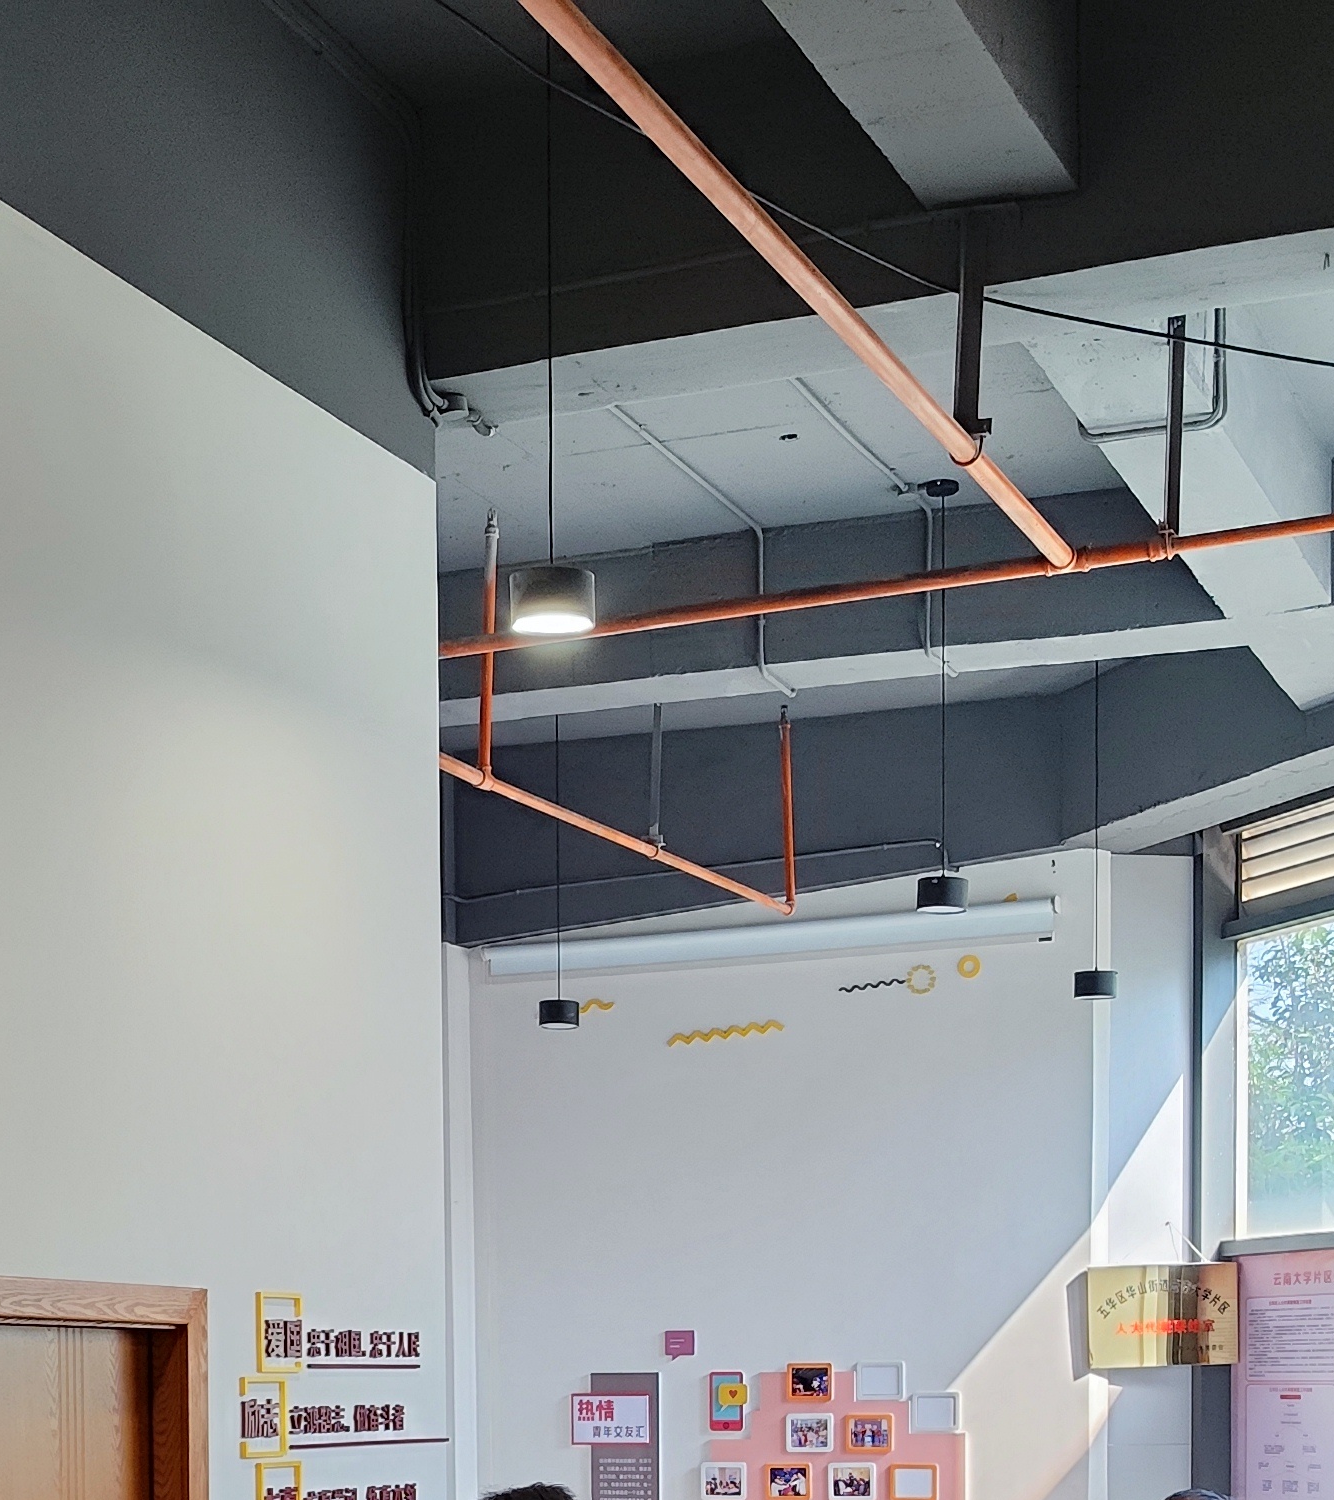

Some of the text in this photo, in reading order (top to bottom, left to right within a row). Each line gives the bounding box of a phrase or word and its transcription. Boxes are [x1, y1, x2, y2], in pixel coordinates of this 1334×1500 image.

[264, 1319, 302, 1358] 爱国
[241, 1399, 279, 1438] 励志
[577, 1399, 615, 1422] 热情
[592, 1425, 645, 1438] 青年交友汇
